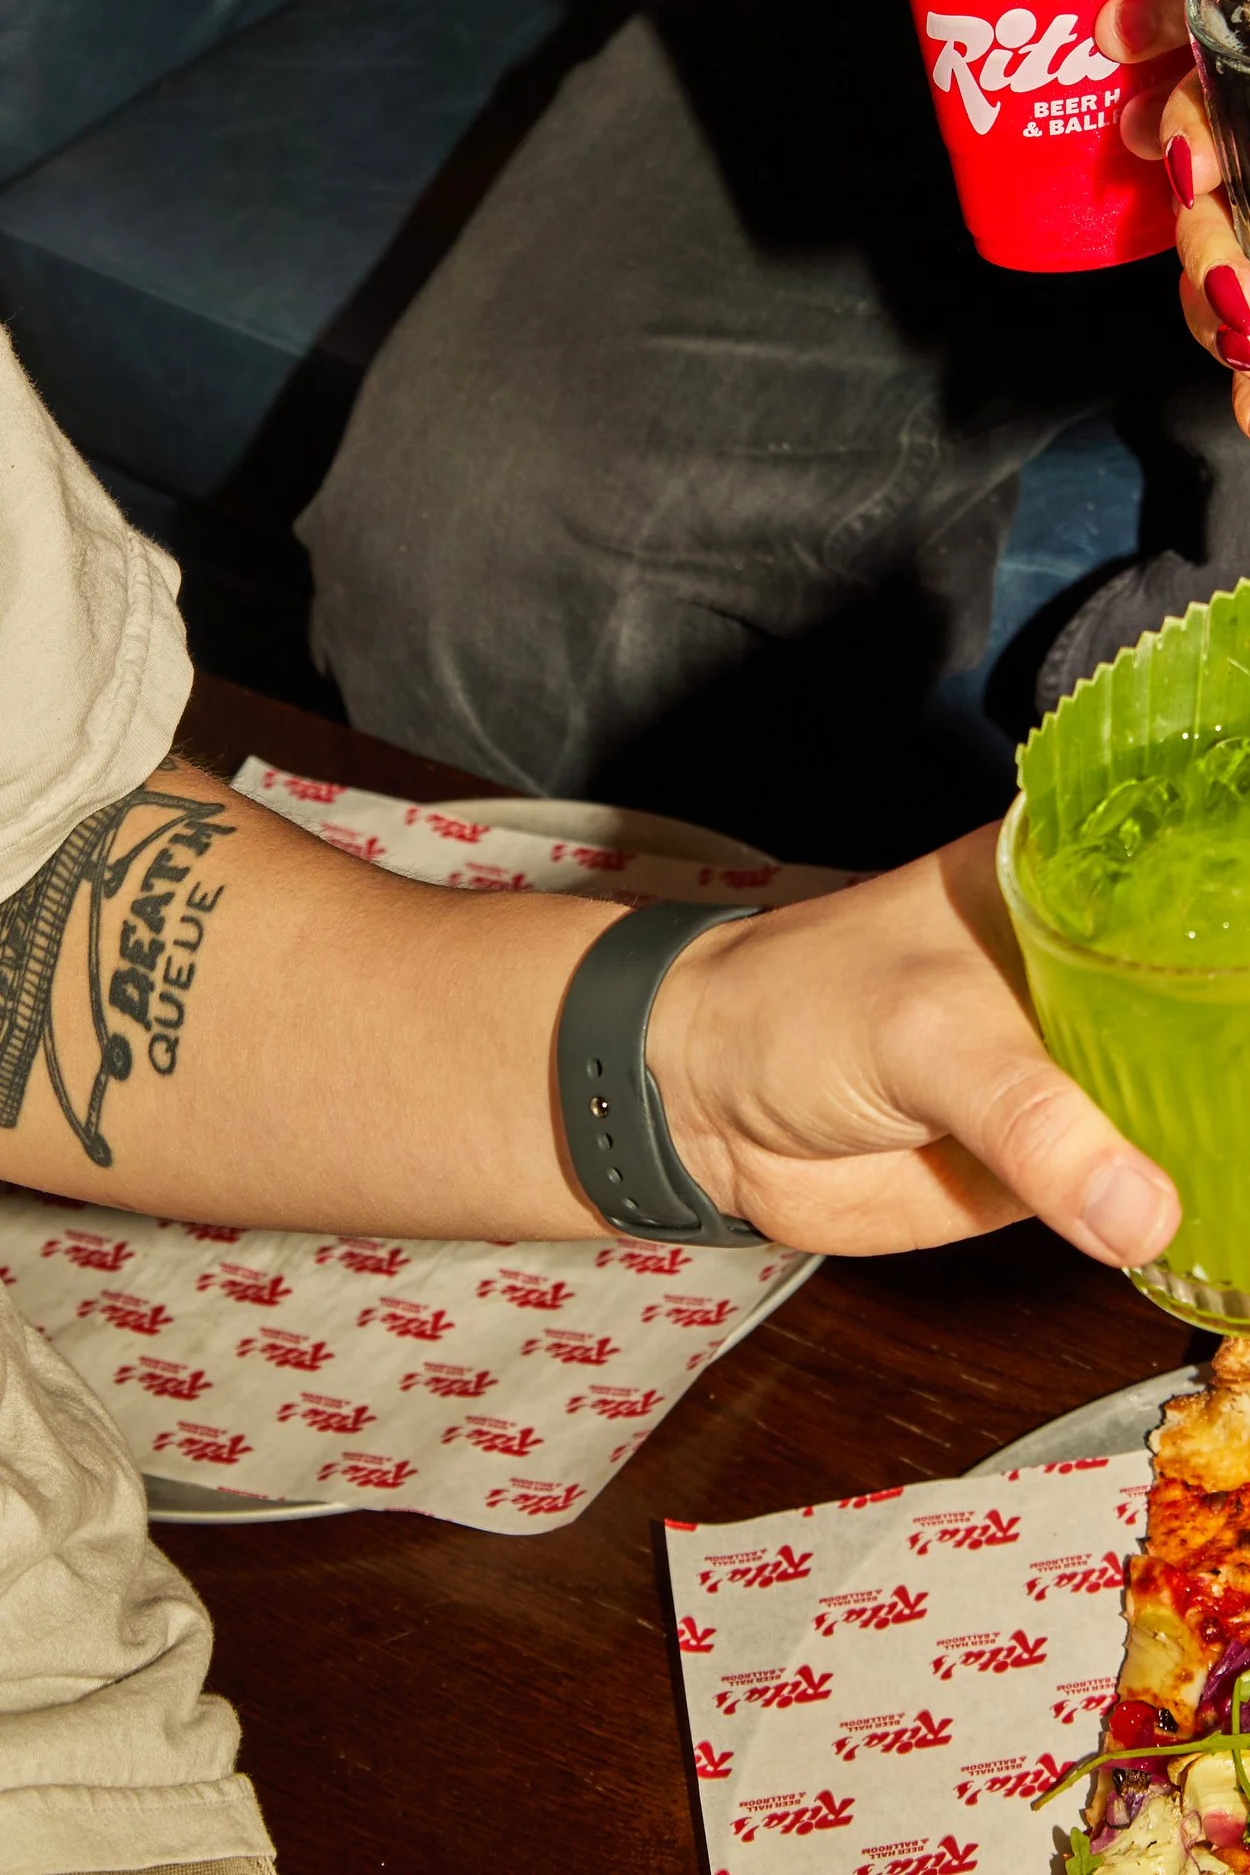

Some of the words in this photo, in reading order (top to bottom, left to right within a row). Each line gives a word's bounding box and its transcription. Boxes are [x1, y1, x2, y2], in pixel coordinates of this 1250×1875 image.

[926, 8, 1120, 135] Rita
[1034, 97, 1097, 119] BEER
[1022, 122, 1042, 137] &
[108, 816, 238, 1032] DEATH
[147, 881, 227, 1076] QUEUE
[905, 1508, 1022, 1556] Rita's
[696, 1545, 814, 1595] Rita's
[1023, 1552, 1125, 1601] Rita's
[811, 1585, 929, 1638] Rita's
[937, 1633, 990, 1646] BALLROOM
[944, 1642, 969, 1651] HALL
[971, 1638, 996, 1647] BEER
[929, 1628, 1048, 1680] Rita's
[721, 1668, 776, 1682] BALLROOM
[728, 1678, 754, 1686] HALL
[756, 1674, 781, 1683] BEER
[712, 1664, 834, 1716] Rita's
[840, 1714, 895, 1728] BALLROOM
[847, 1724, 873, 1732] HALL
[875, 1719, 900, 1729] BEER
[831, 1709, 954, 1762] Rita's
[961, 1758, 1016, 1772] BALLROOM
[969, 1768, 995, 1776] HALL
[997, 1763, 1022, 1773] BEER
[953, 1753, 1076, 1806] Rita's
[739, 1794, 795, 1807] BALLROOM
[746, 1803, 773, 1812] HALL
[775, 1799, 801, 1808] BEER
[730, 1789, 855, 1843] Rita's
[853, 1834, 979, 1875] Ritas
[861, 1840, 918, 1855] BALLROOM
[898, 1845, 924, 1855] BEER
[869, 1850, 896, 1860] HALL
